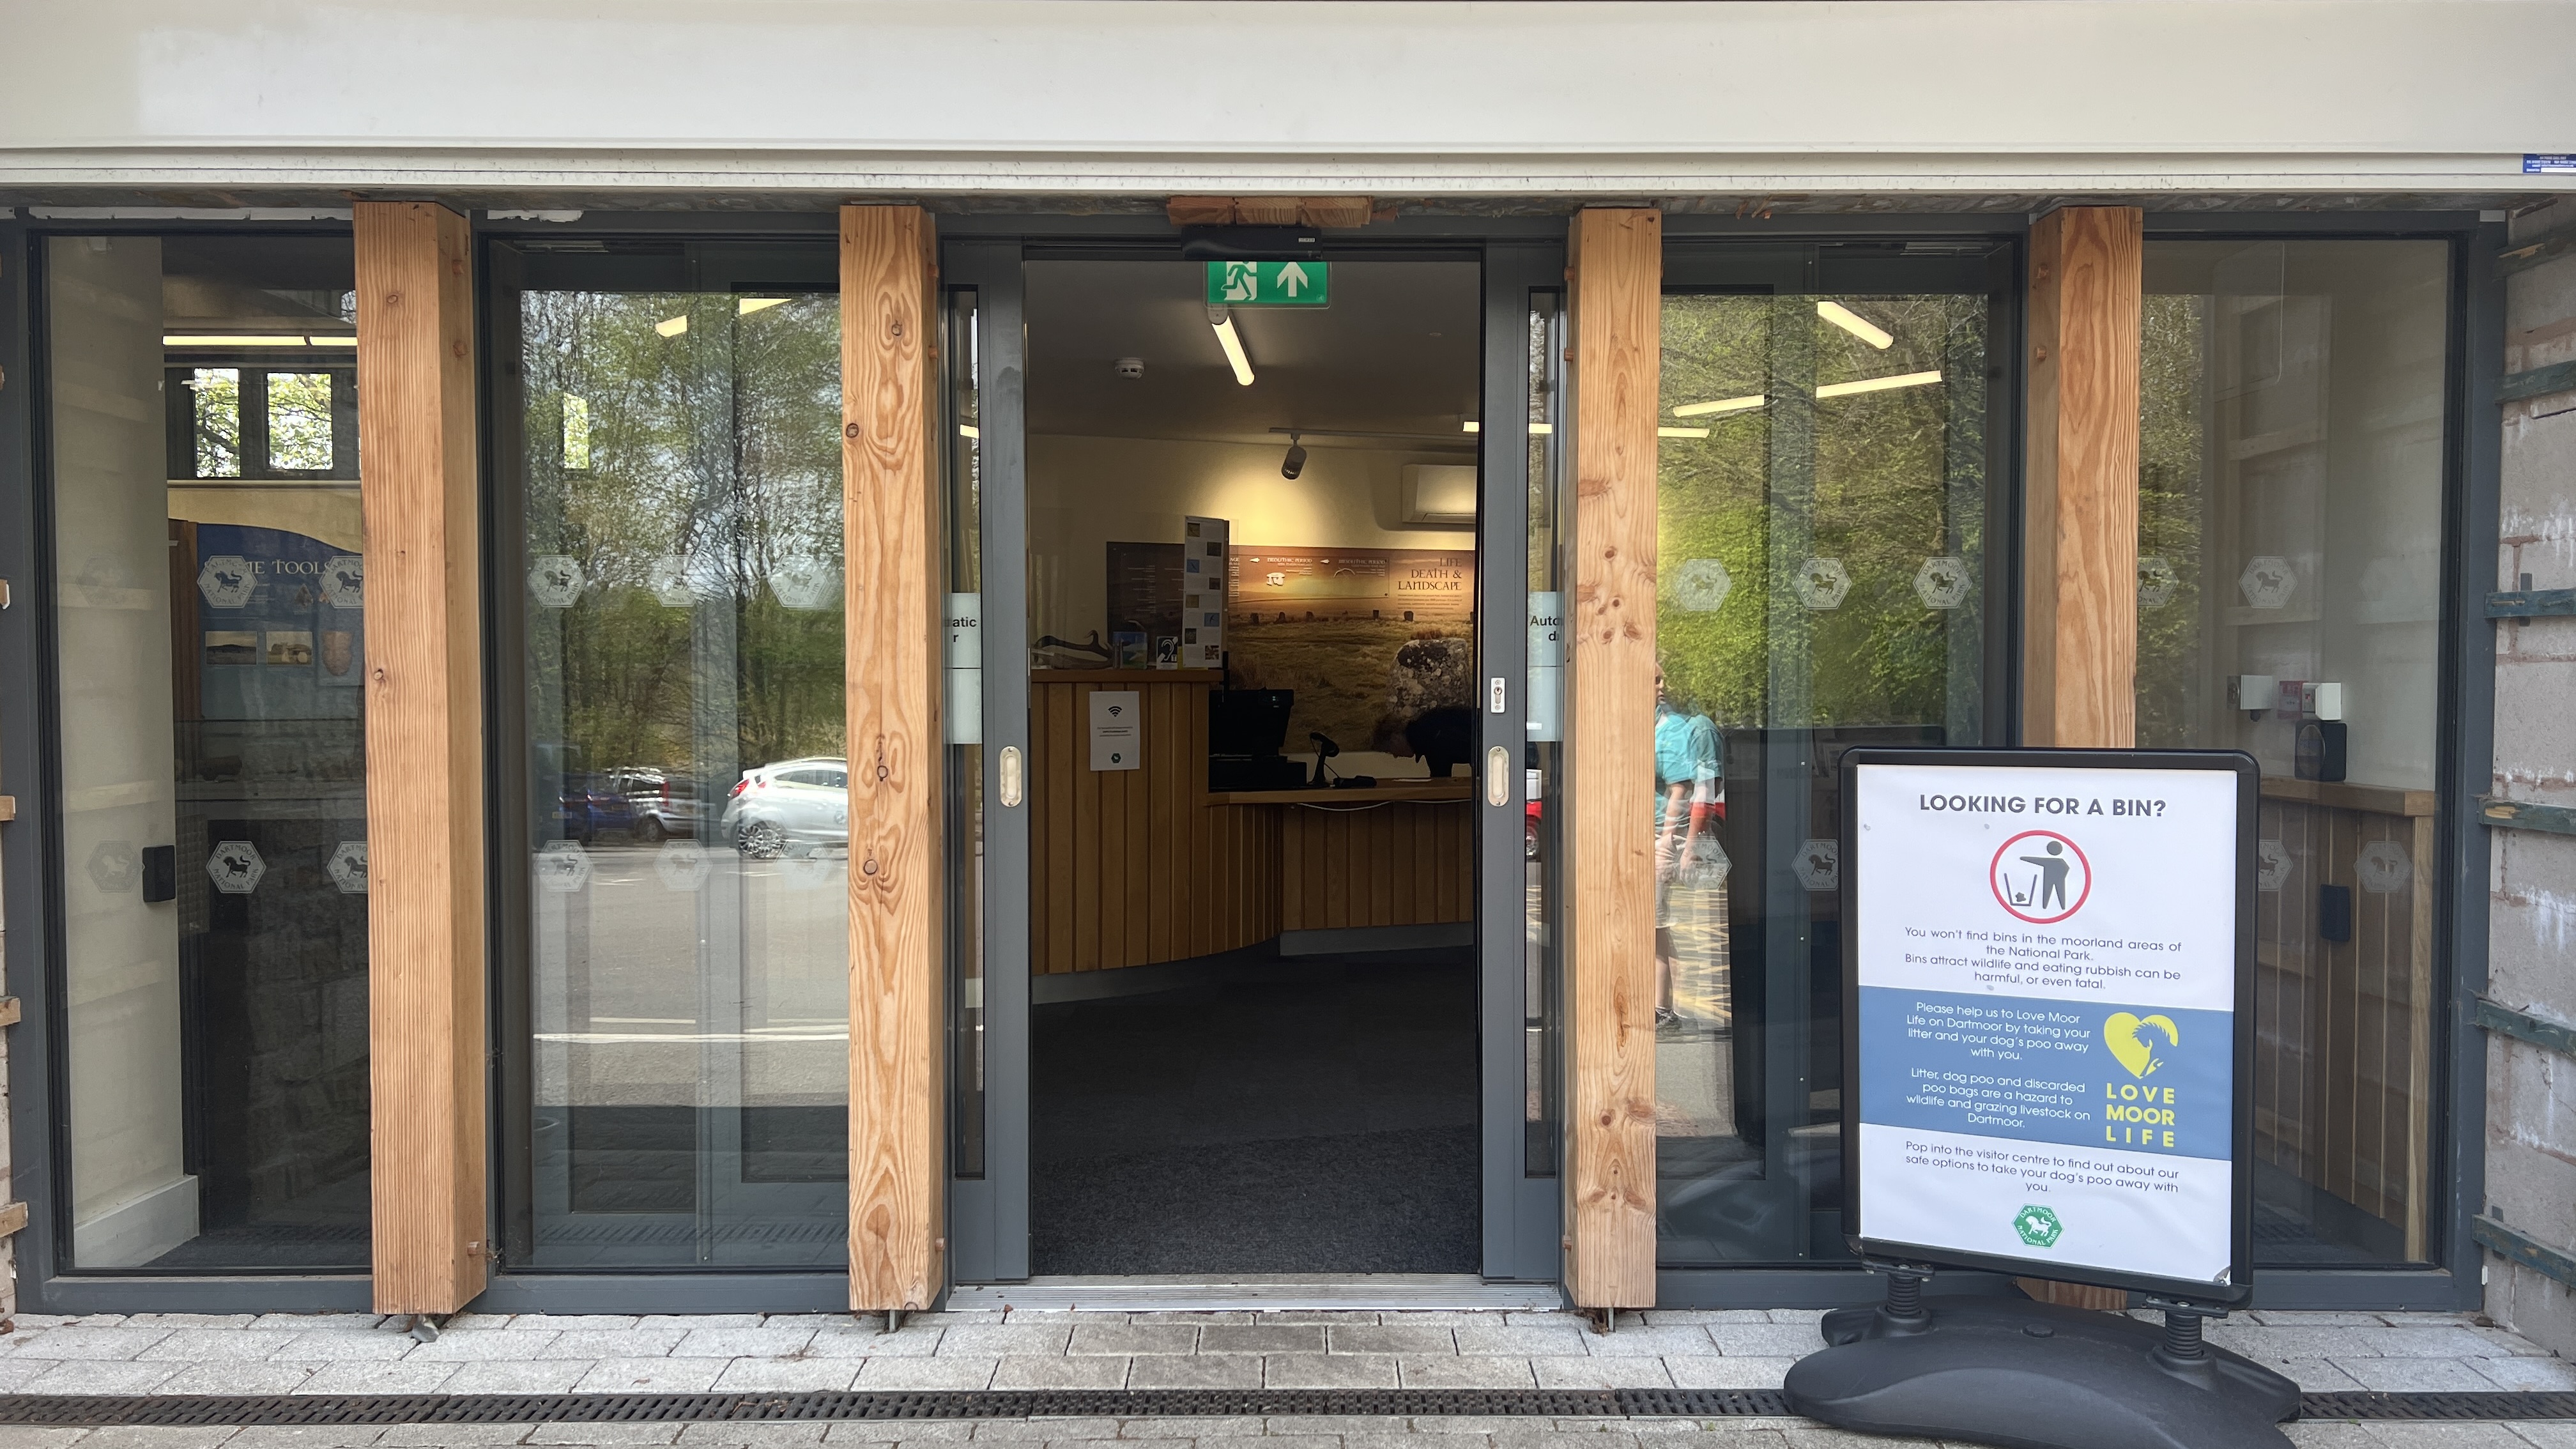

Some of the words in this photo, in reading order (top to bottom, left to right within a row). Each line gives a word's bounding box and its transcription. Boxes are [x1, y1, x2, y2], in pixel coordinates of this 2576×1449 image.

[1440, 557, 1462, 567] LIFE
[1802, 561, 1843, 576] DARTMOOR
[1922, 560, 1963, 576] DARTMOOR
[1411, 568, 1448, 578] DEATH
[1452, 569, 1462, 579] &
[1397, 581, 1462, 590] LANDSCAPE
[1951, 583, 1966, 601] PARK
[1920, 794, 2027, 813] LOOKING
[2035, 797, 2080, 815] FOR
[2087, 798, 2104, 815] A
[2113, 799, 2166, 817] BIN?
[215, 844, 257, 861] DARTMOOR
[336, 844, 368, 859] DARTMO
[1800, 843, 1838, 857] DARTMOO
[213, 868, 245, 890] NATIONAL
[1905, 926, 1926, 937] You
[1931, 930, 1962, 939] won't
[1966, 930, 1988, 941] find
[1993, 931, 2017, 942] bins
[2022, 933, 2032, 944] in
[2037, 934, 2056, 945] the
[2062, 937, 2122, 949] moorland
[2128, 941, 2163, 951] areas
[2168, 942, 2182, 952] of
[1986, 945, 2005, 955] the
[2009, 946, 2060, 959] National
[2064, 949, 2094, 961] Park.
[1905, 953, 1927, 964] Bins
[1930, 955, 1968, 967] attract
[1970, 958, 2011, 969] wildlife
[2014, 962, 2039, 971] and
[2043, 963, 2082, 976] eating
[2085, 965, 2131, 977] rubbish
[2135, 970, 2159, 979] can
[2164, 970, 2181, 980] be
[1974, 970, 2023, 985] harmful,
[2042, 977, 2071, 987] even
[2075, 977, 2106, 990] fatal.
[1917, 1002, 1954, 1014] Please
[1957, 1005, 1983, 1018] help
[1986, 1009, 1998, 1018] us
[2000, 1009, 2014, 1019] to
[2016, 1009, 2045, 1021] Love
[2048, 1011, 2080, 1023] Moor
[1907, 1015, 1926, 1025] Life
[1929, 1018, 1944, 1027] on
[1947, 1017, 2003, 1031] Dartmoor
[2005, 1022, 2021, 1035] by
[2023, 1023, 2061, 1038] taking
[2064, 1029, 2091, 1039] your
[1908, 1027, 1933, 1039] litter
[1935, 1032, 1959, 1041] and
[1961, 1034, 1988, 1044] your
[1989, 1034, 2024, 1048] dog's
[2027, 1039, 2051, 1049] poo
[2054, 1041, 2089, 1054] away
[1970, 1047, 1995, 1057] with
[1997, 1050, 2023, 1061] you.
[1912, 1068, 1939, 1080] Litter,
[1943, 1071, 1967, 1084] dog
[1970, 1075, 1994, 1085] poo
[1997, 1077, 2021, 1087] and
[2024, 1078, 2085, 1092] discarded
[1922, 1084, 1947, 1093] poo
[1949, 1084, 1979, 1098] bags
[1981, 1089, 2001, 1099] are
[2004, 1091, 2012, 1100] a
[2016, 1091, 2057, 1104] hazard
[2060, 1094, 2073, 1105] to
[2107, 1083, 2174, 1104] LOVE
[1906, 1094, 1945, 1107] wildlife
[1947, 1099, 1971, 1109] and
[1974, 1102, 2017, 1116] grazing
[2020, 1105, 2071, 1119] livestock
[2074, 1112, 2090, 1121] on
[2106, 1104, 2175, 1125] MOOR
[1968, 1112, 2025, 1128] Dartmoor.
[2106, 1126, 2174, 1147] LIFE
[1906, 1140, 1928, 1153] Pop
[1931, 1144, 1952, 1154] into
[1955, 1146, 1974, 1157] the
[1976, 1149, 2009, 1161] visitor
[2012, 1154, 2050, 1165] centre
[2053, 1156, 2065, 1167] to
[2068, 1158, 2090, 1169] find
[2094, 1163, 2114, 1172] out
[2117, 1164, 2155, 1176] about
[2158, 1170, 2179, 1179] our
[1906, 1155, 1929, 1165] safe
[1932, 1158, 1975, 1170] options
[1977, 1162, 1989, 1172] to
[1991, 1163, 2017, 1175] take
[2020, 1169, 2047, 1178] your
[2050, 1170, 2083, 1184] dog's
[2087, 1176, 2112, 1186] poo
[2115, 1179, 2150, 1192] away
[2154, 1183, 2178, 1193] with
[2025, 1183, 2051, 1192] you.
[2019, 1206, 2057, 1223] DARTMOOR
[2017, 1224, 2046, 1246] NATIONAL
[2046, 1228, 2059, 1244] PARK
